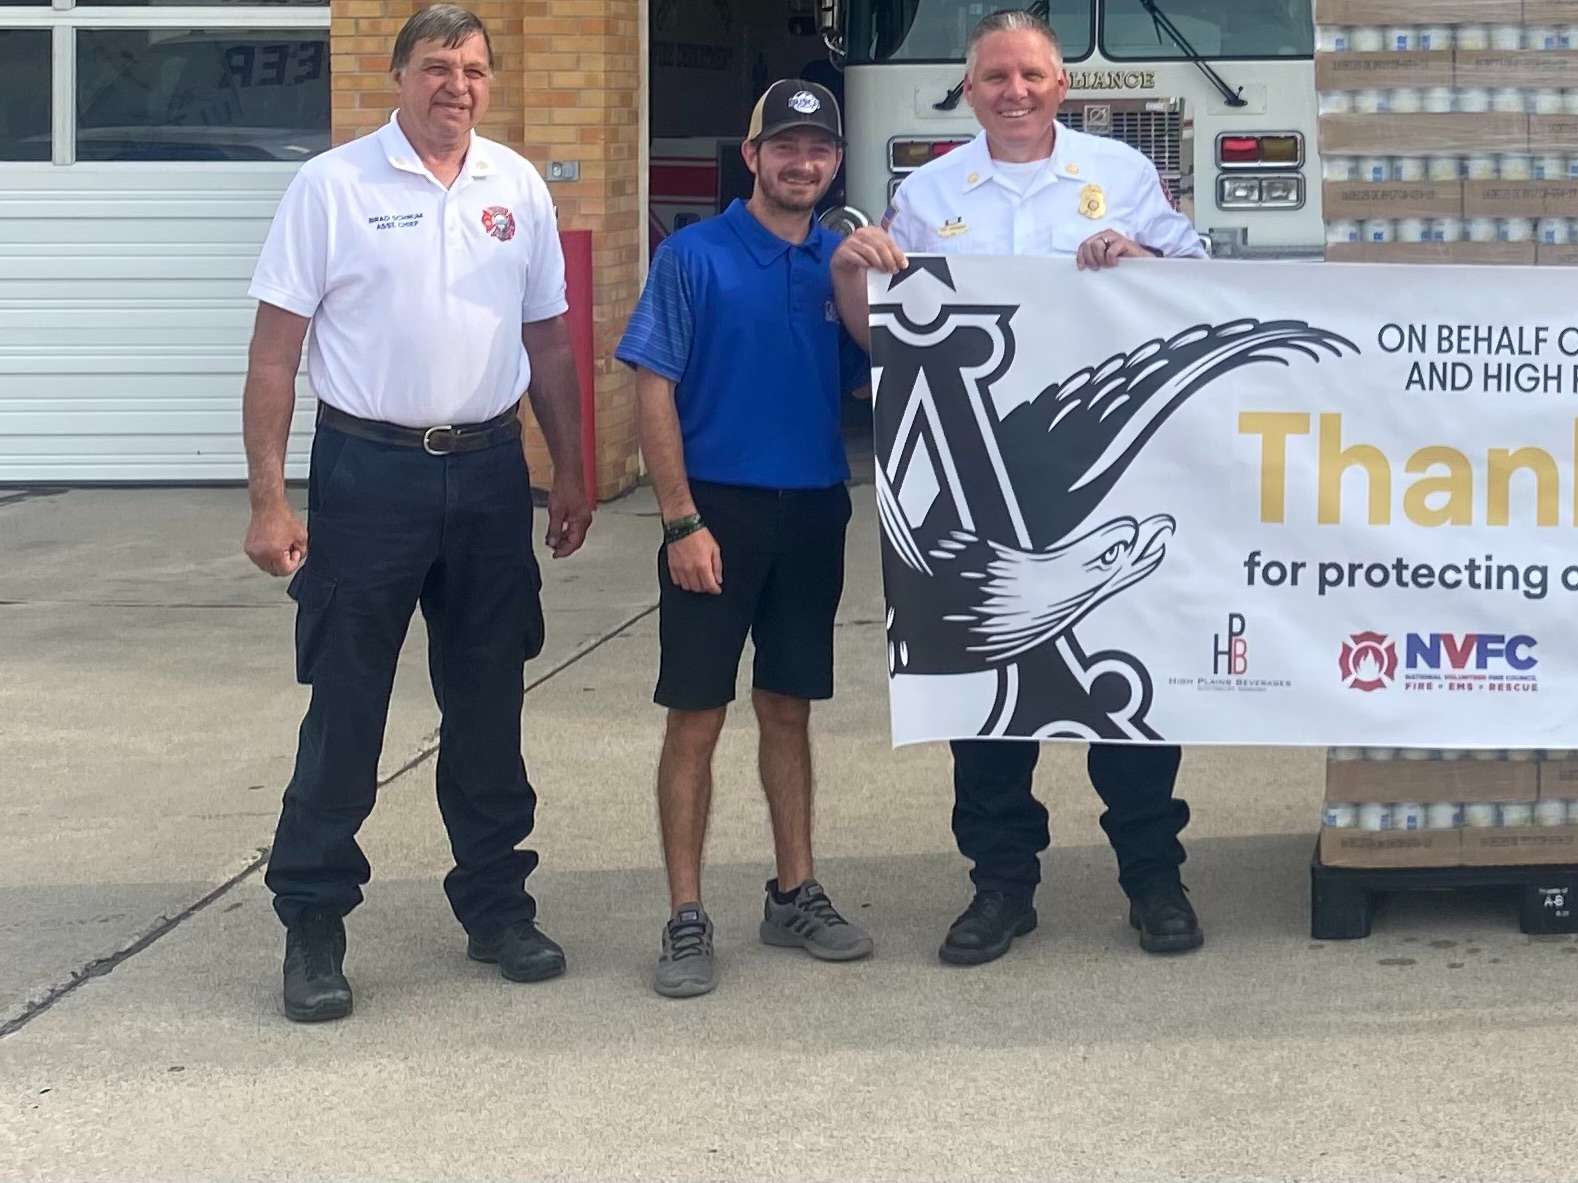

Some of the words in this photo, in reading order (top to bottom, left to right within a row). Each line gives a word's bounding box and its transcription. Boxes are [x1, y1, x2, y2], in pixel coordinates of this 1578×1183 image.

[1377, 322, 1427, 354] ON
[1436, 324, 1549, 357] BEHALF
[1405, 360, 1474, 392] AND
[1483, 361, 1563, 394] HIGH
[1243, 550, 1307, 587] for
[1317, 553, 1549, 600] protecting
[1405, 632, 1539, 671] NVFC
[1404, 681, 1434, 691] FIRE
[1448, 682, 1474, 692] EMS
[1487, 683, 1539, 692] RESCUE
